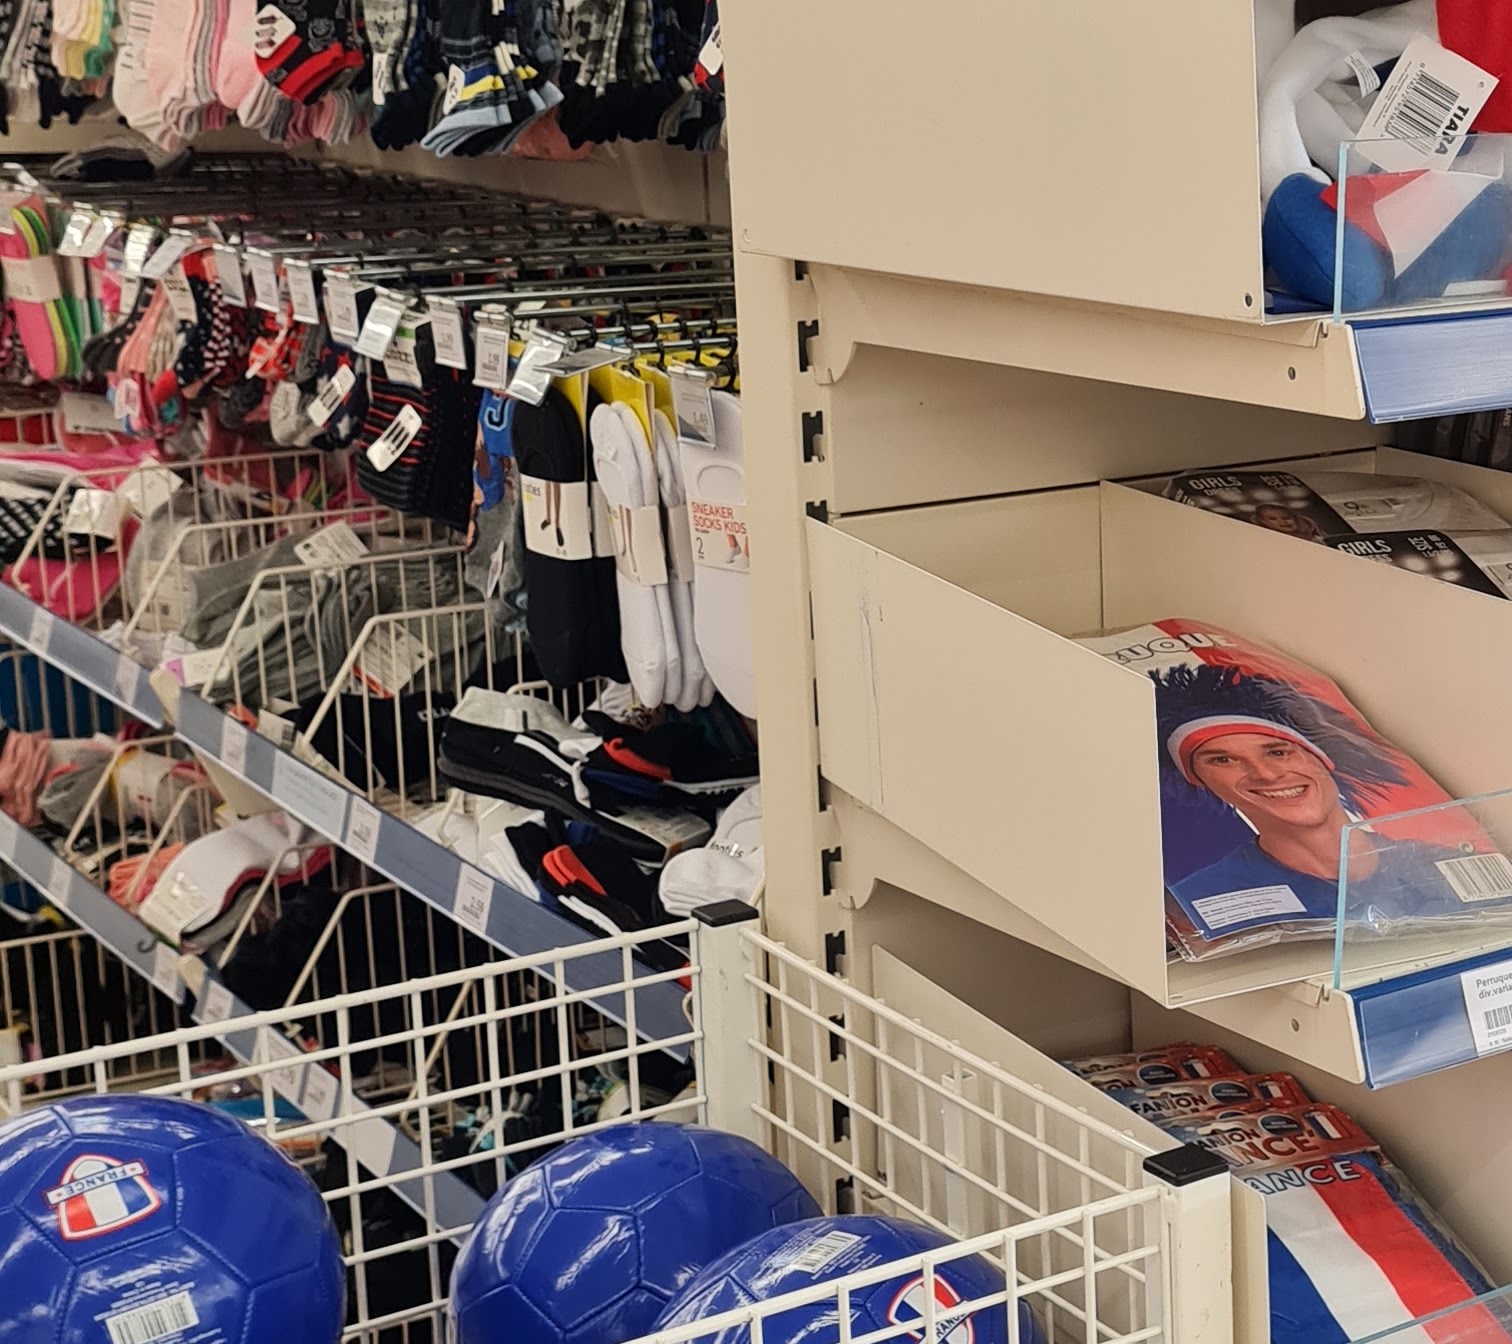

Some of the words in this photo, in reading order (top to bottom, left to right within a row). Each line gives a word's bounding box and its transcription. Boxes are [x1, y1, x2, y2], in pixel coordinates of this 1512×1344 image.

[1435, 105, 1469, 155] TIARA
[1188, 475, 1243, 491] GIRLS
[691, 502, 734, 519] SNEAKER
[693, 515, 722, 530] SOCKS
[724, 521, 747, 534] KIDS
[1337, 539, 1393, 556] GIRLS
[1131, 1095, 1208, 1114] FANION
[1197, 1129, 1261, 1150] ANION
[63, 1166, 127, 1196] FRANCE
